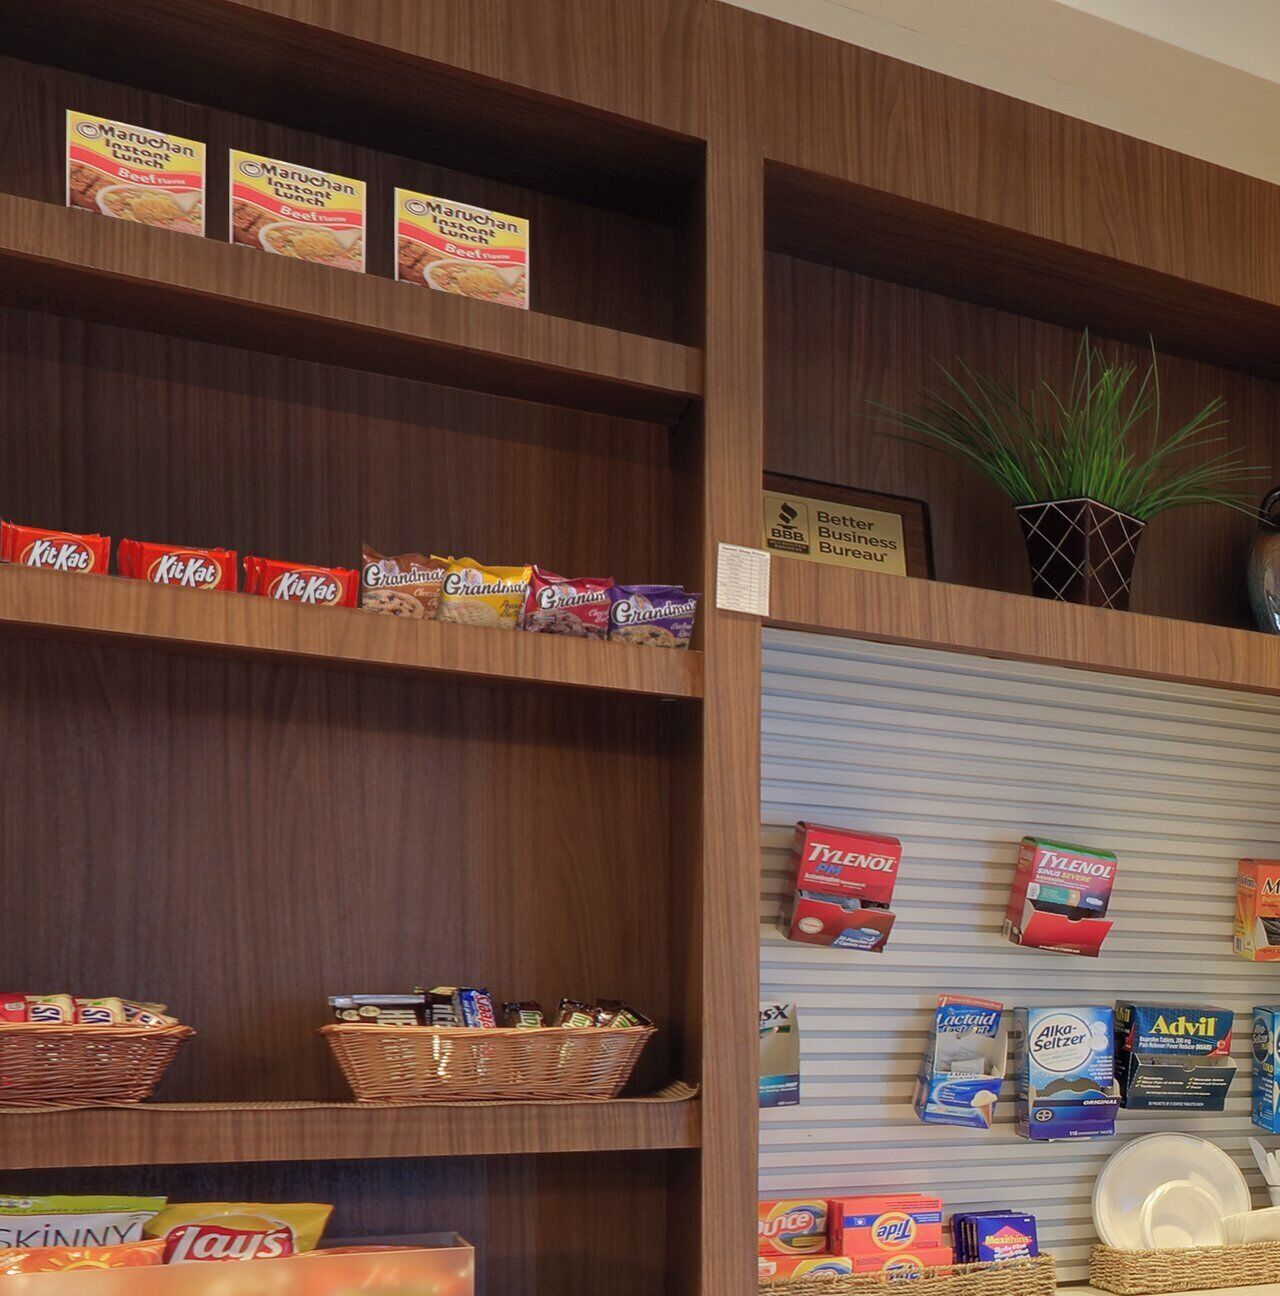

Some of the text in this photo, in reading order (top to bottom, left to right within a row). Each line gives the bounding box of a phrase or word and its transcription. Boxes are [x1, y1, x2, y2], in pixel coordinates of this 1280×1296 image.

[98, 124, 194, 157] Maruchan
[105, 138, 171, 162] Instant
[112, 150, 164, 170] Lunch
[118, 167, 156, 185] Beef
[261, 163, 355, 195] Maruchan
[267, 177, 332, 200] Instant
[275, 189, 325, 208] Lunch
[280, 205, 319, 223] Beef
[426, 201, 518, 233] Maruchan
[432, 215, 496, 238] Instant
[439, 226, 489, 245] Lunch
[445, 243, 482, 260] Beef
[817, 511, 874, 531] Better
[771, 528, 804, 541] BBB
[818, 527, 897, 550] Business
[819, 542, 885, 562] Bureau
[443, 572, 527, 596] Grandma's
[610, 599, 696, 625] Grandma's
[808, 842, 896, 873] TYLENOL
[1039, 850, 1111, 879] TYLENOL
[815, 863, 842, 876] PM
[1037, 868, 1061, 877] SINUS
[937, 1012, 996, 1027] Lactaid
[1148, 1015, 1215, 1037] Advil
[1033, 1034, 1086, 1052] Seltzer
[1037, 1025, 1077, 1040] Alka-
[877, 1215, 912, 1241] Tide
[171, 1226, 290, 1260] Lay's
